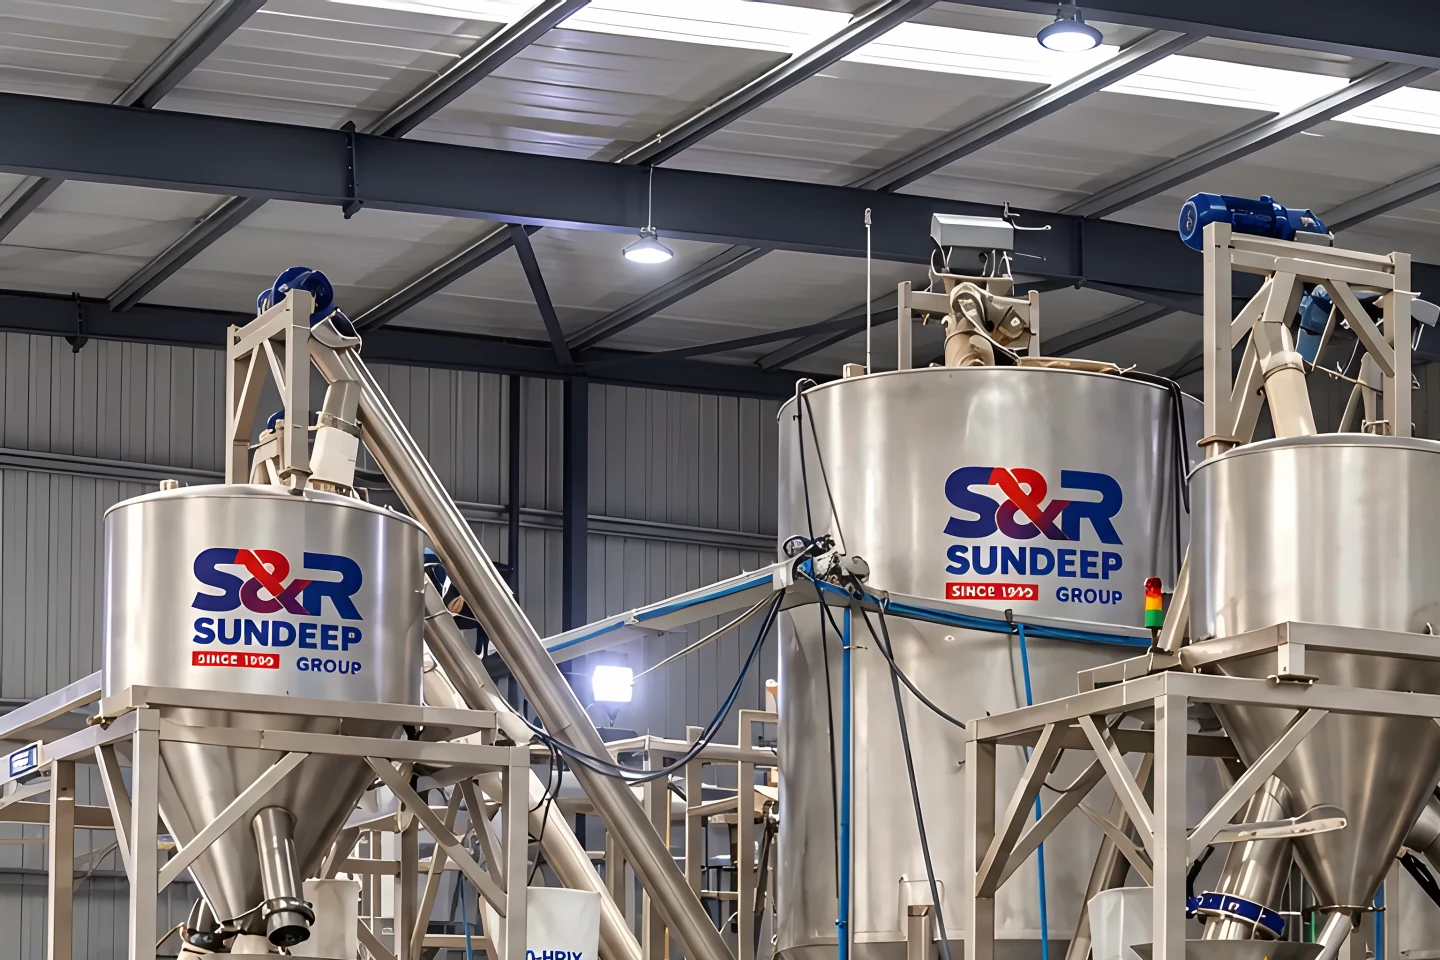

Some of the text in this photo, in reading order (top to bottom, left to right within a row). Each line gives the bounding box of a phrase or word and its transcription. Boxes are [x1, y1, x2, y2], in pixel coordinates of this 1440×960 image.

[943, 466, 1124, 545] S&R
[945, 545, 1123, 580] SUNDEEP
[191, 547, 364, 620] S&R
[1056, 586, 1123, 605] GROUP
[192, 617, 363, 652] SUNDEEP
[296, 656, 362, 675] GROUP
